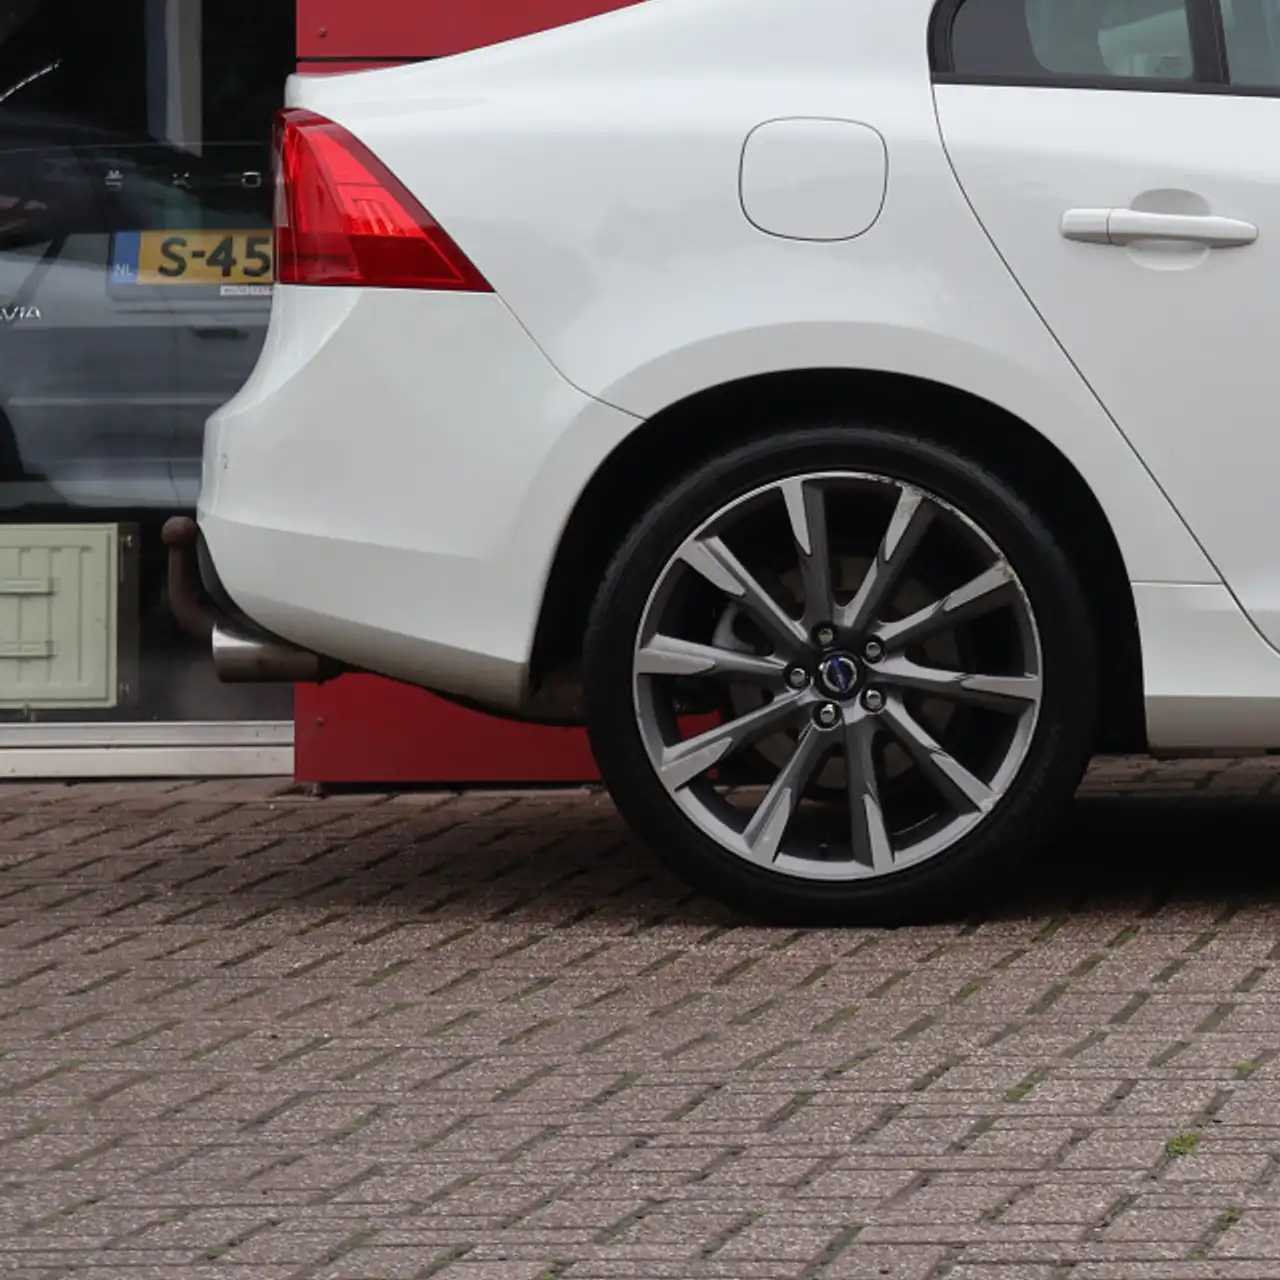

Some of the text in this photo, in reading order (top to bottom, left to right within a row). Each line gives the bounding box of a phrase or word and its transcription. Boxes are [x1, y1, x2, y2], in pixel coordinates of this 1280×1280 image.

[114, 235, 272, 278] NL S-45
[0, 305, 41, 323] VIA
